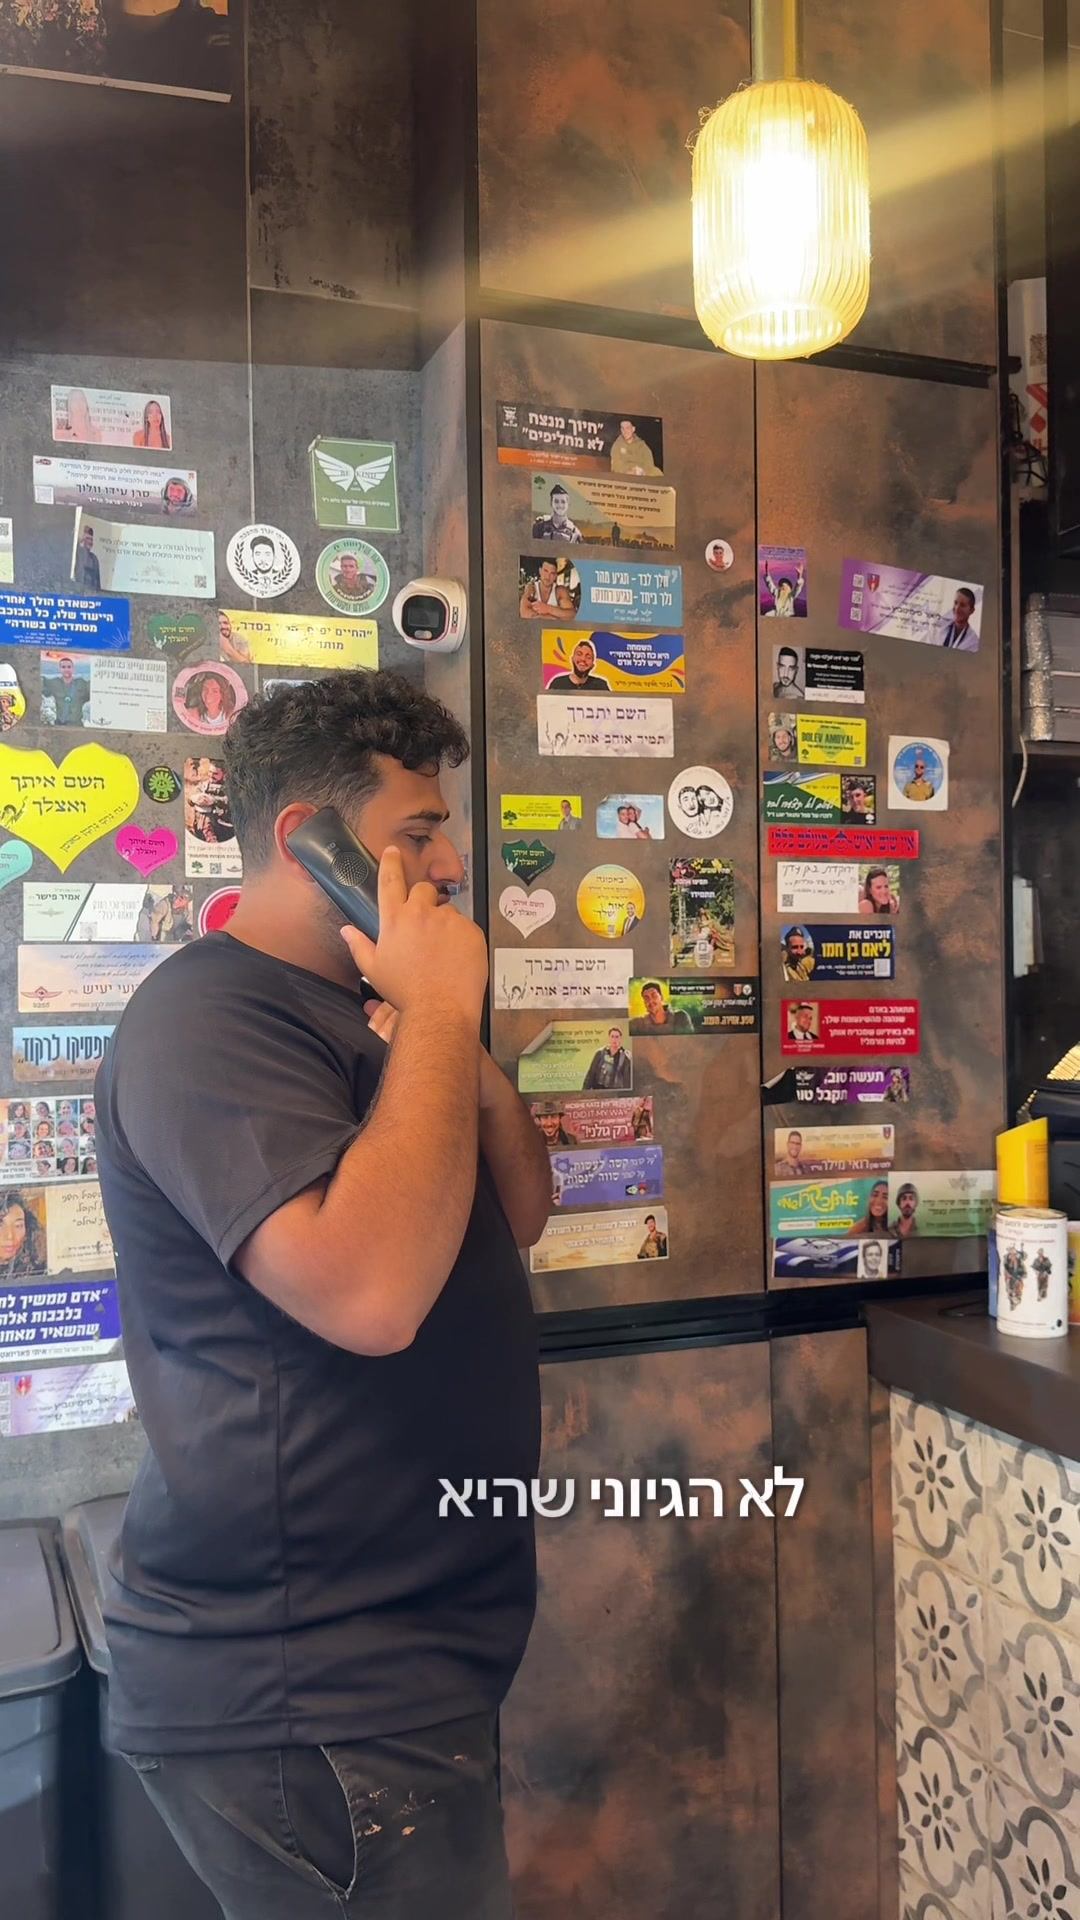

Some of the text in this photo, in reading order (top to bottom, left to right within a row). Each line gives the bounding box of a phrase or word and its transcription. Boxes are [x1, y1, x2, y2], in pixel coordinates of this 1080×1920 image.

[529, 412, 565, 429] מנצח
[568, 418, 604, 436] "חיוך
[522, 426, 604, 451] לא מחליפים"
[76, 483, 150, 498] סרן עידו וולוך
[595, 570, 610, 584] מהר
[638, 573, 652, 587] לבד
[29, 596, 55, 608] הולך
[57, 599, 102, 609] "כשאדם
[640, 592, 658, 605] ביחד
[35, 607, 114, 623] הייעוד שלו, כל
[5, 619, 98, 633] מסתדרים בשורה"
[236, 621, 272, 633] בסדר,
[335, 628, 373, 639] "החיים
[627, 644, 653, 652] השמחה
[633, 659, 646, 667] לכל
[567, 705, 647, 724] השם יתברך
[573, 733, 666, 745] תמיד אוהב אותי
[11, 775, 105, 791] השם איתך
[32, 797, 87, 816] ואצלך
[35, 893, 81, 901] אמיר פישר
[849, 930, 891, 940] זוכרים את
[821, 940, 891, 961] ליאם בן חמו
[525, 958, 607, 975] השם יתברך
[83, 984, 140, 995] ועי יעיש
[530, 985, 625, 996] תמיד אוהב אותי
[824, 1071, 885, 1085] תעשה טוב,
[816, 1088, 848, 1104] תקבל
[821, 1158, 869, 1171] רואי מילר
[598, 1172, 619, 1181] שווה
[20, 1288, 109, 1310] "אדם ממשיך
[30, 1306, 83, 1324] בלבבות
[40, 1323, 100, 1340] שהשאיר
